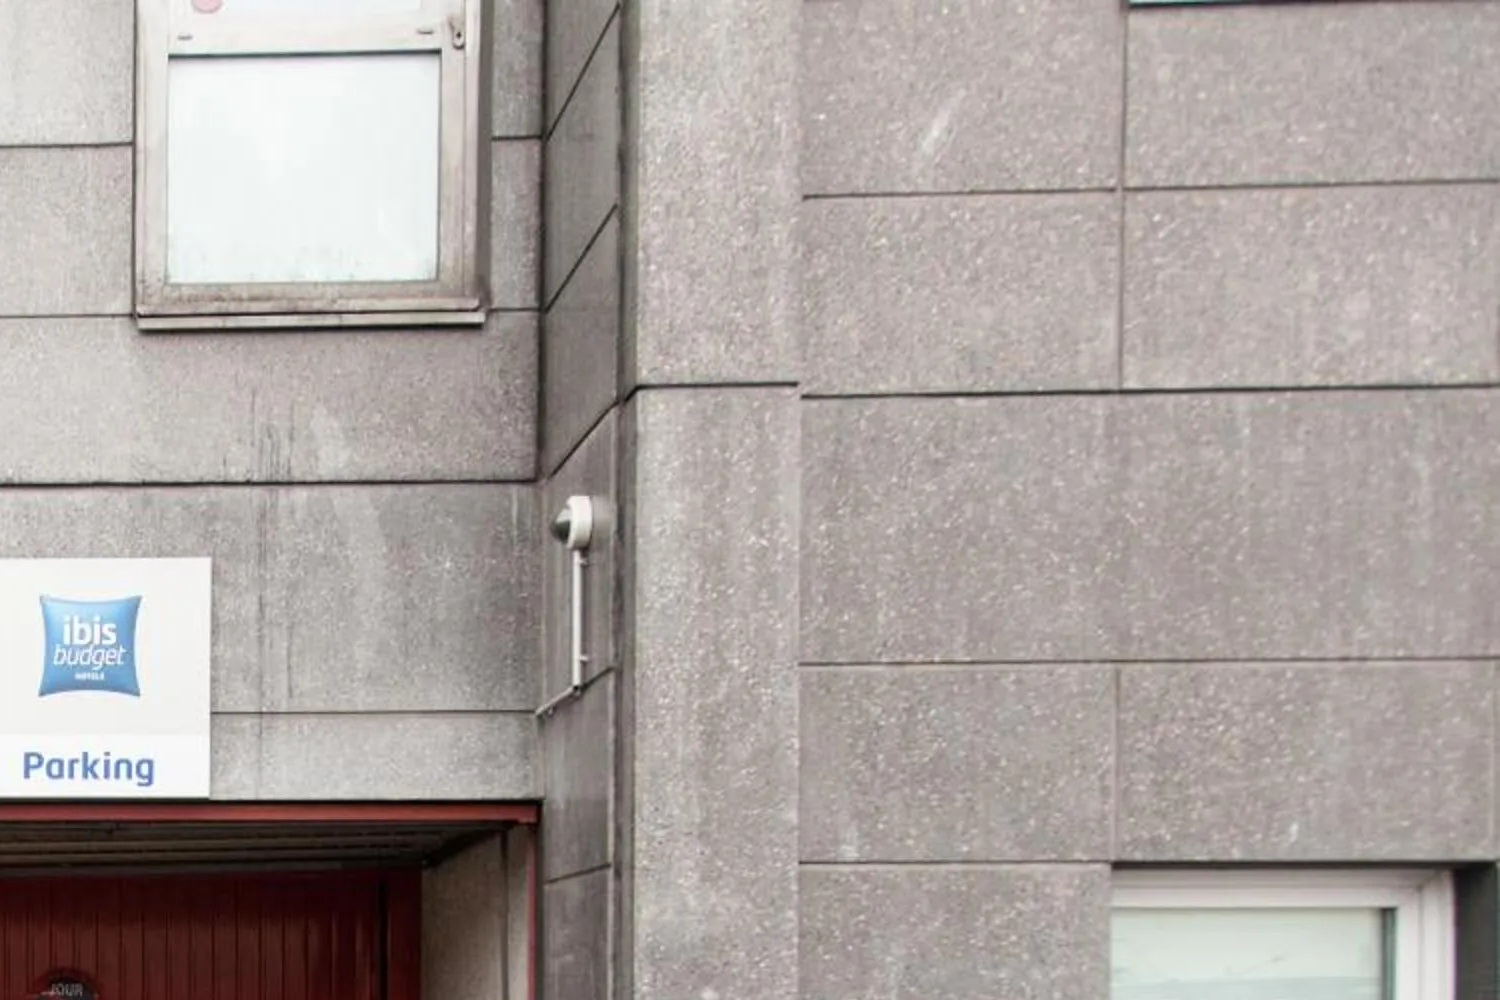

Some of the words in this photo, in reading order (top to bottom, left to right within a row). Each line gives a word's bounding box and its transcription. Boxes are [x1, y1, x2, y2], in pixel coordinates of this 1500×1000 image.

[63, 614, 117, 645] ibis
[53, 644, 127, 671] budget
[23, 751, 155, 787] Parking
[50, 983, 83, 997] JOUR
